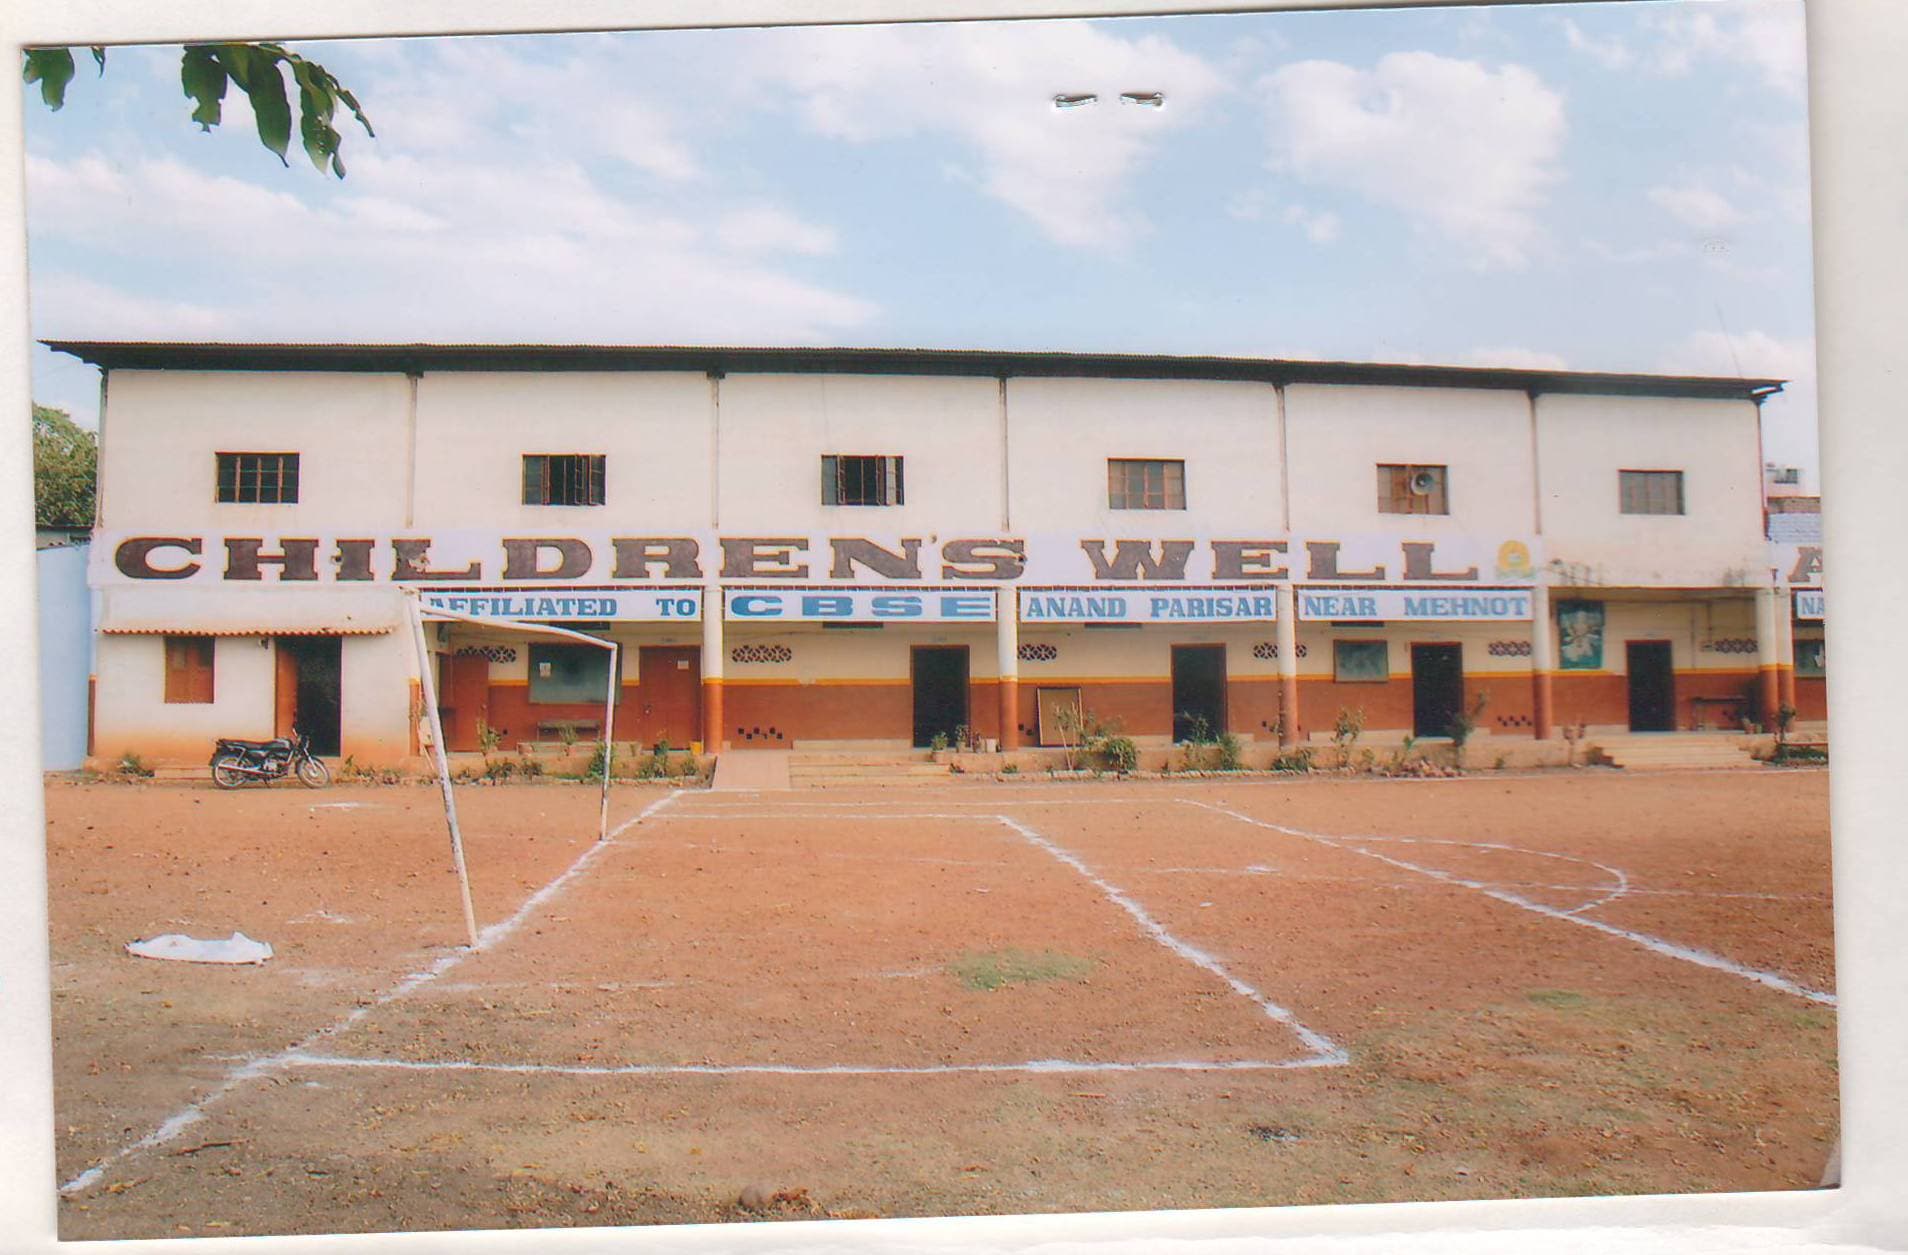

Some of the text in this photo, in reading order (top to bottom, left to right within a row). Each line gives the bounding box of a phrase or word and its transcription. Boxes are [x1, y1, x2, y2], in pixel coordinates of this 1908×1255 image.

[115, 537, 1478, 581] CHILDREN'S WELL
[656, 598, 696, 616] TO
[730, 596, 991, 617] CBSE
[1026, 596, 1273, 618] ANAND PARISAR
[1304, 596, 1528, 617] NEAR MEHNOT
